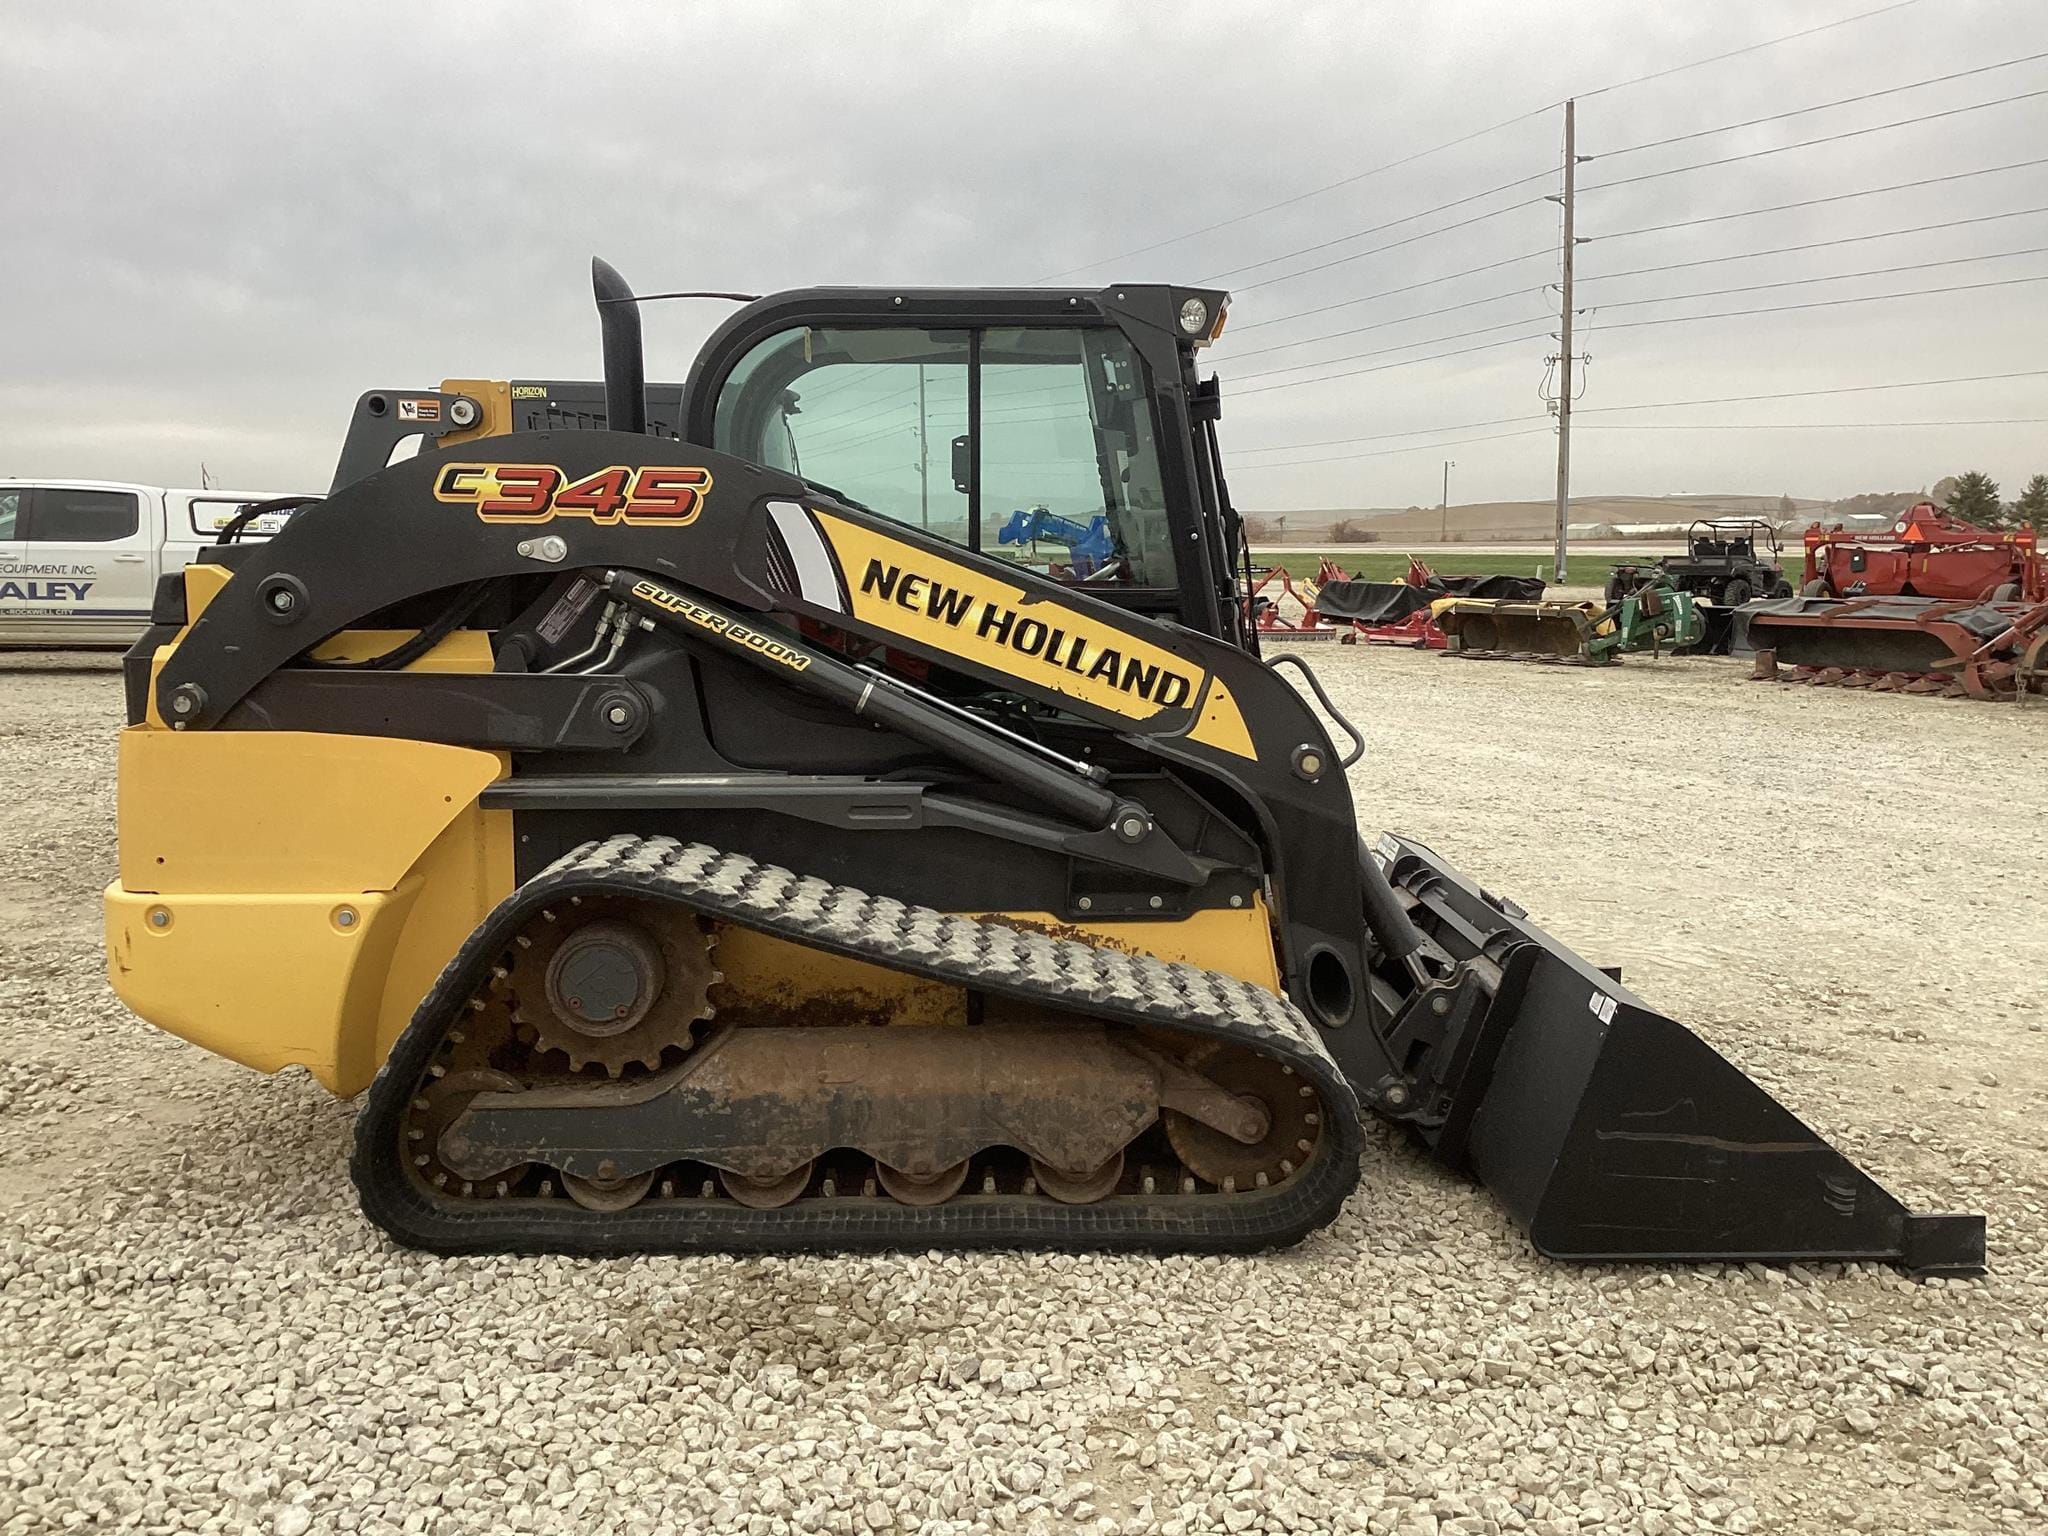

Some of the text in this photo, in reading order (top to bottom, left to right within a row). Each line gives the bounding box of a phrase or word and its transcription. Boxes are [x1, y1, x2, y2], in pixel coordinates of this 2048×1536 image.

[511, 386, 548, 398] HORIZON
[436, 464, 712, 524] C345
[71, 565, 97, 575] INC.
[632, 581, 728, 633] SUPER
[725, 624, 811, 671] BOOM
[859, 557, 1191, 707] NEW HOLLAND
